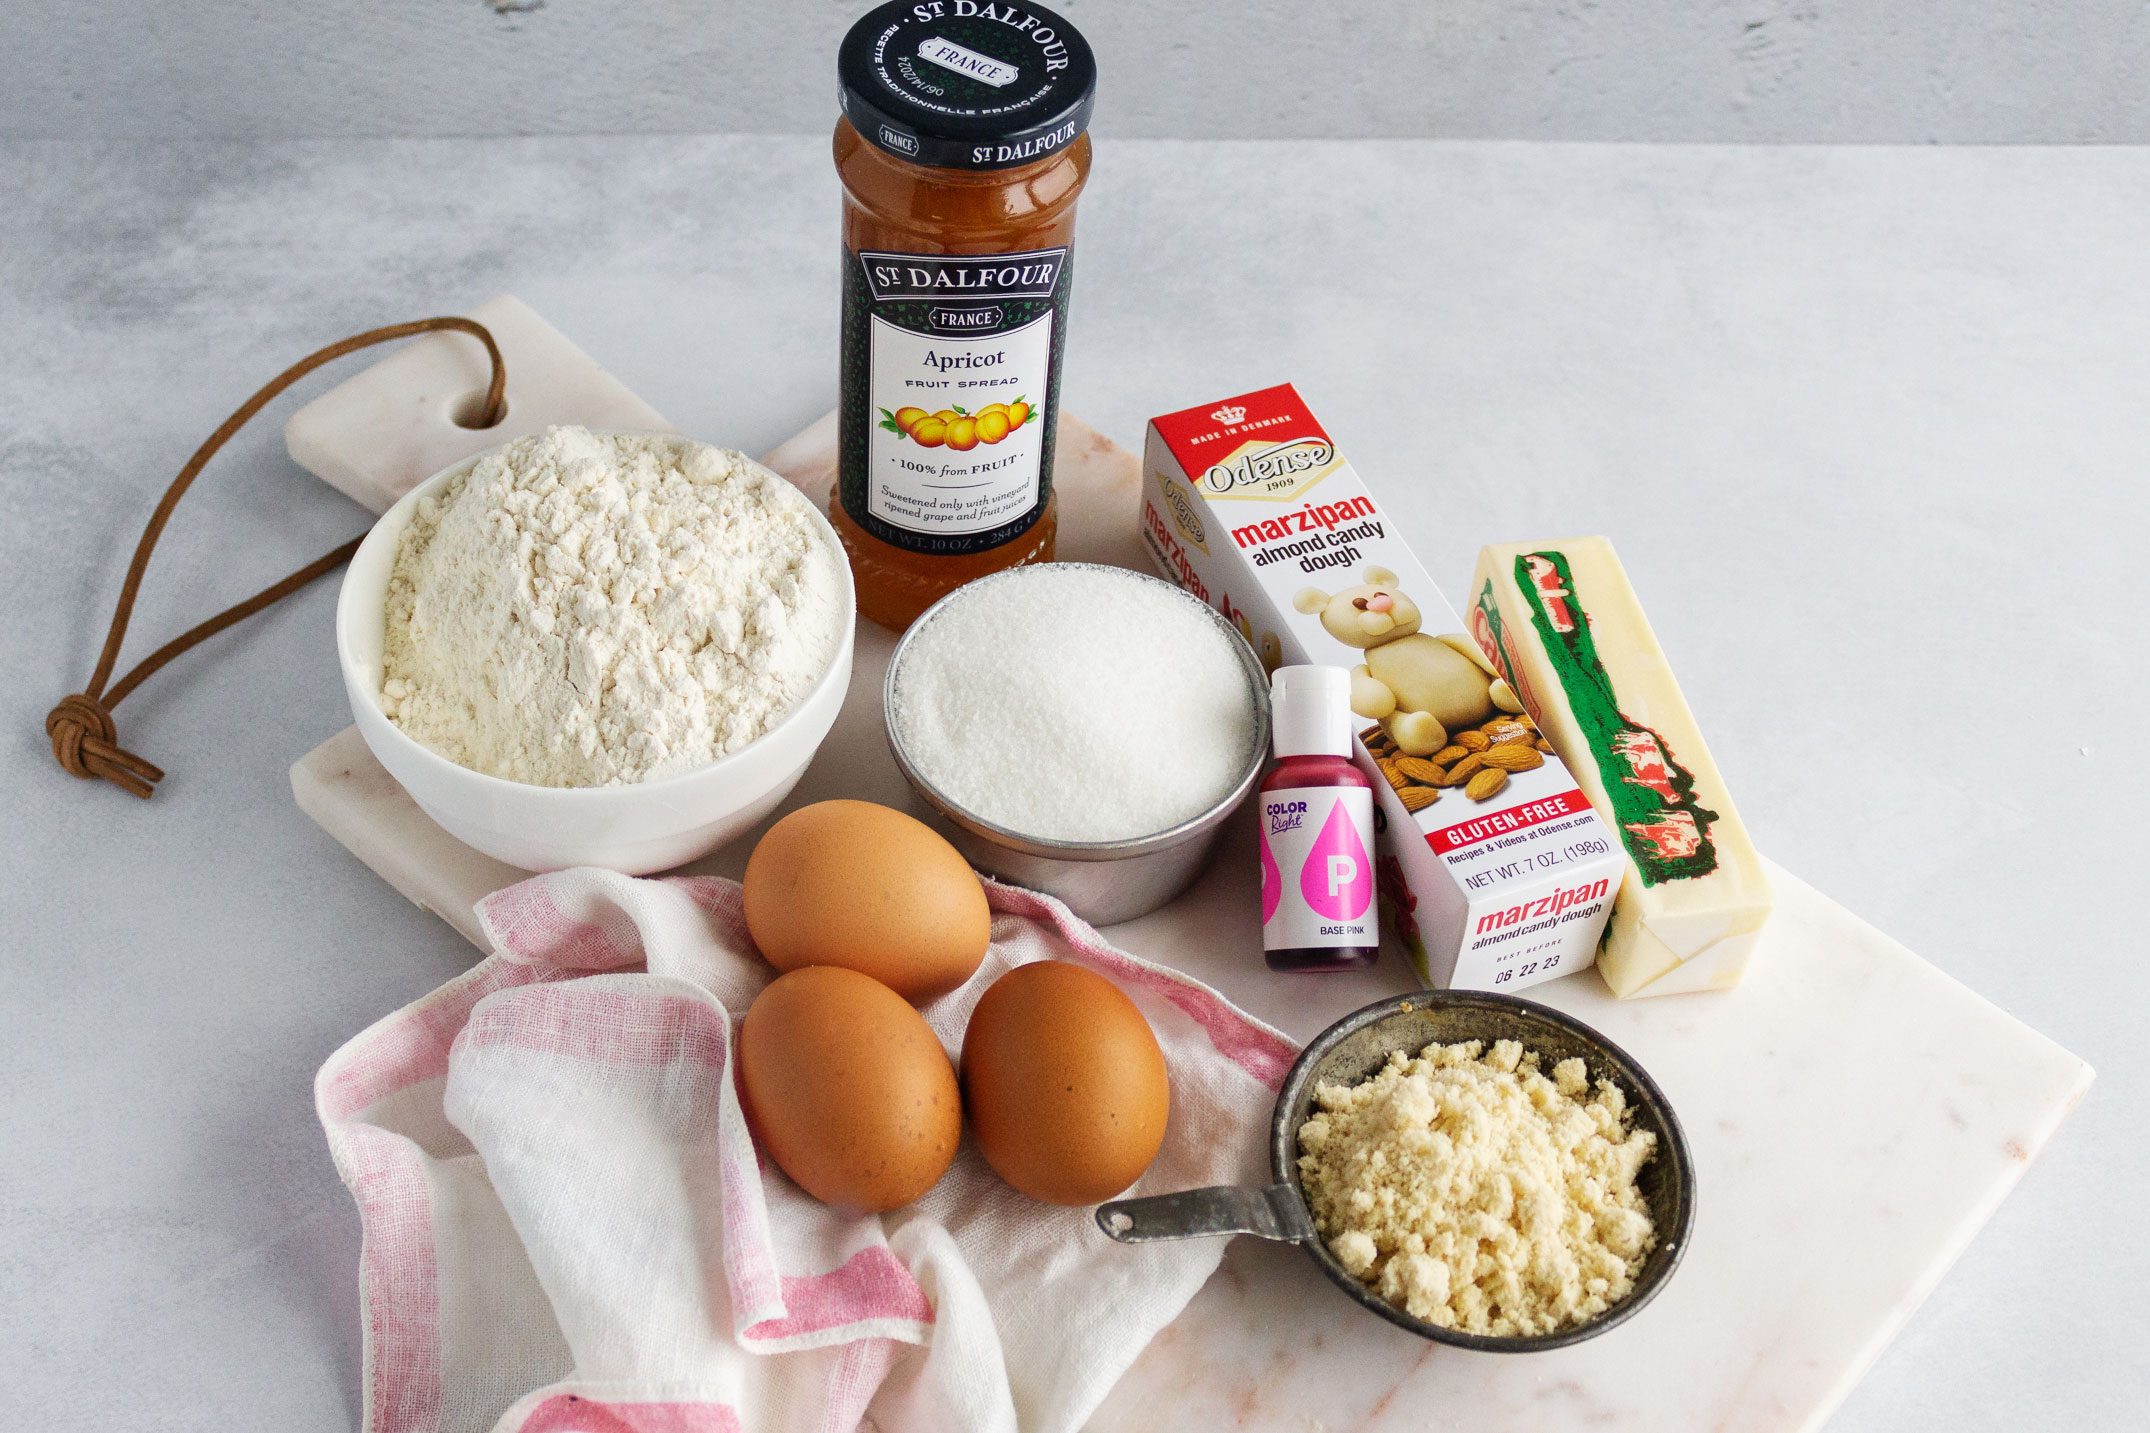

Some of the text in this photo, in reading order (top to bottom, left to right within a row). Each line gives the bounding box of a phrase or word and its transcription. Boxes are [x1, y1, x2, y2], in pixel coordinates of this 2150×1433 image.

[875, 23, 899, 64] RECETTE
[954, 0, 1069, 72] DALFOUR
[935, 46, 1002, 79] FRANCE
[878, 66, 976, 115] TRADITIONNELLE
[884, 130, 913, 151] FRANCE
[997, 120, 1075, 163] DALFOUR
[907, 263, 1053, 288] DALFOUR
[940, 311, 992, 326] FRANCE
[922, 350, 1005, 373] Apricot
[905, 377, 1019, 389] FRUIT SPREAD
[1191, 414, 1293, 446] MADE IN DENMARK
[900, 454, 1017, 478] 100% from FRUIT
[1203, 436, 1335, 493] Odense
[880, 476, 1031, 511] Sweetened only with vineyard
[1266, 477, 1295, 492] 1909
[884, 495, 1027, 523] ripened grape and fruit juices
[1165, 476, 1205, 543] Odense
[1231, 495, 1377, 549] marzipan
[870, 519, 895, 541] NET
[931, 540, 946, 550] 10
[949, 538, 972, 550] OZ
[1252, 519, 1386, 567] almond candy
[1299, 545, 1363, 574] dough
[1266, 801, 1307, 816] COLOR
[1271, 813, 1304, 835] Right
[1446, 797, 1570, 846] GLUTEN-FREE
[1447, 814, 1595, 866] Recipes & Videos at Odense.com
[1327, 855, 1358, 897] P
[1465, 837, 1609, 890] NET WT. 7 OZ. (198g)
[1476, 878, 1609, 935] marzipan
[1320, 926, 1365, 935] BASE PINK
[1471, 902, 1602, 951] almond candy dough
[1496, 938, 1564, 963] BEST BEFORE
[1495, 954, 1560, 984] 06 22 23
